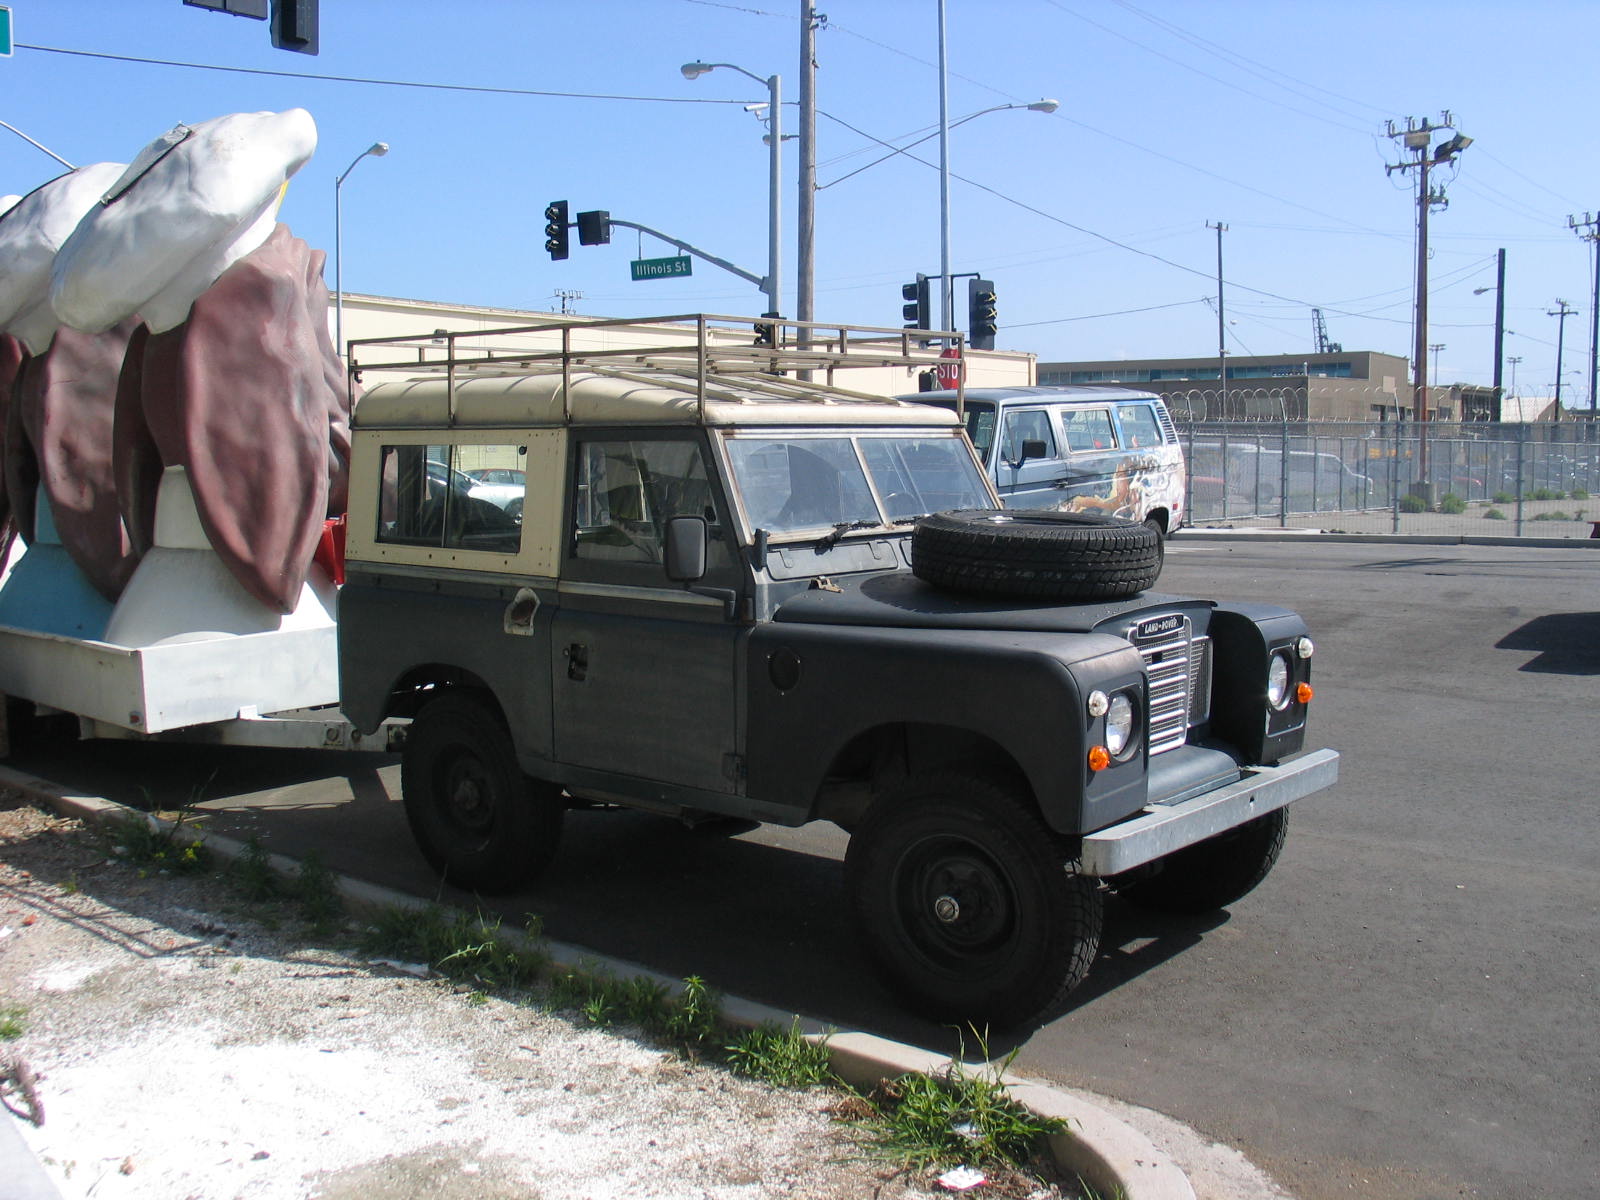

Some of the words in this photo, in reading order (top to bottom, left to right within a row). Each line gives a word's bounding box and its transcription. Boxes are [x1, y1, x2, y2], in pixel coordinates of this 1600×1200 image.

[636, 263, 672, 276] Illinois
[675, 261, 686, 272] St
[939, 362, 961, 379] STO
